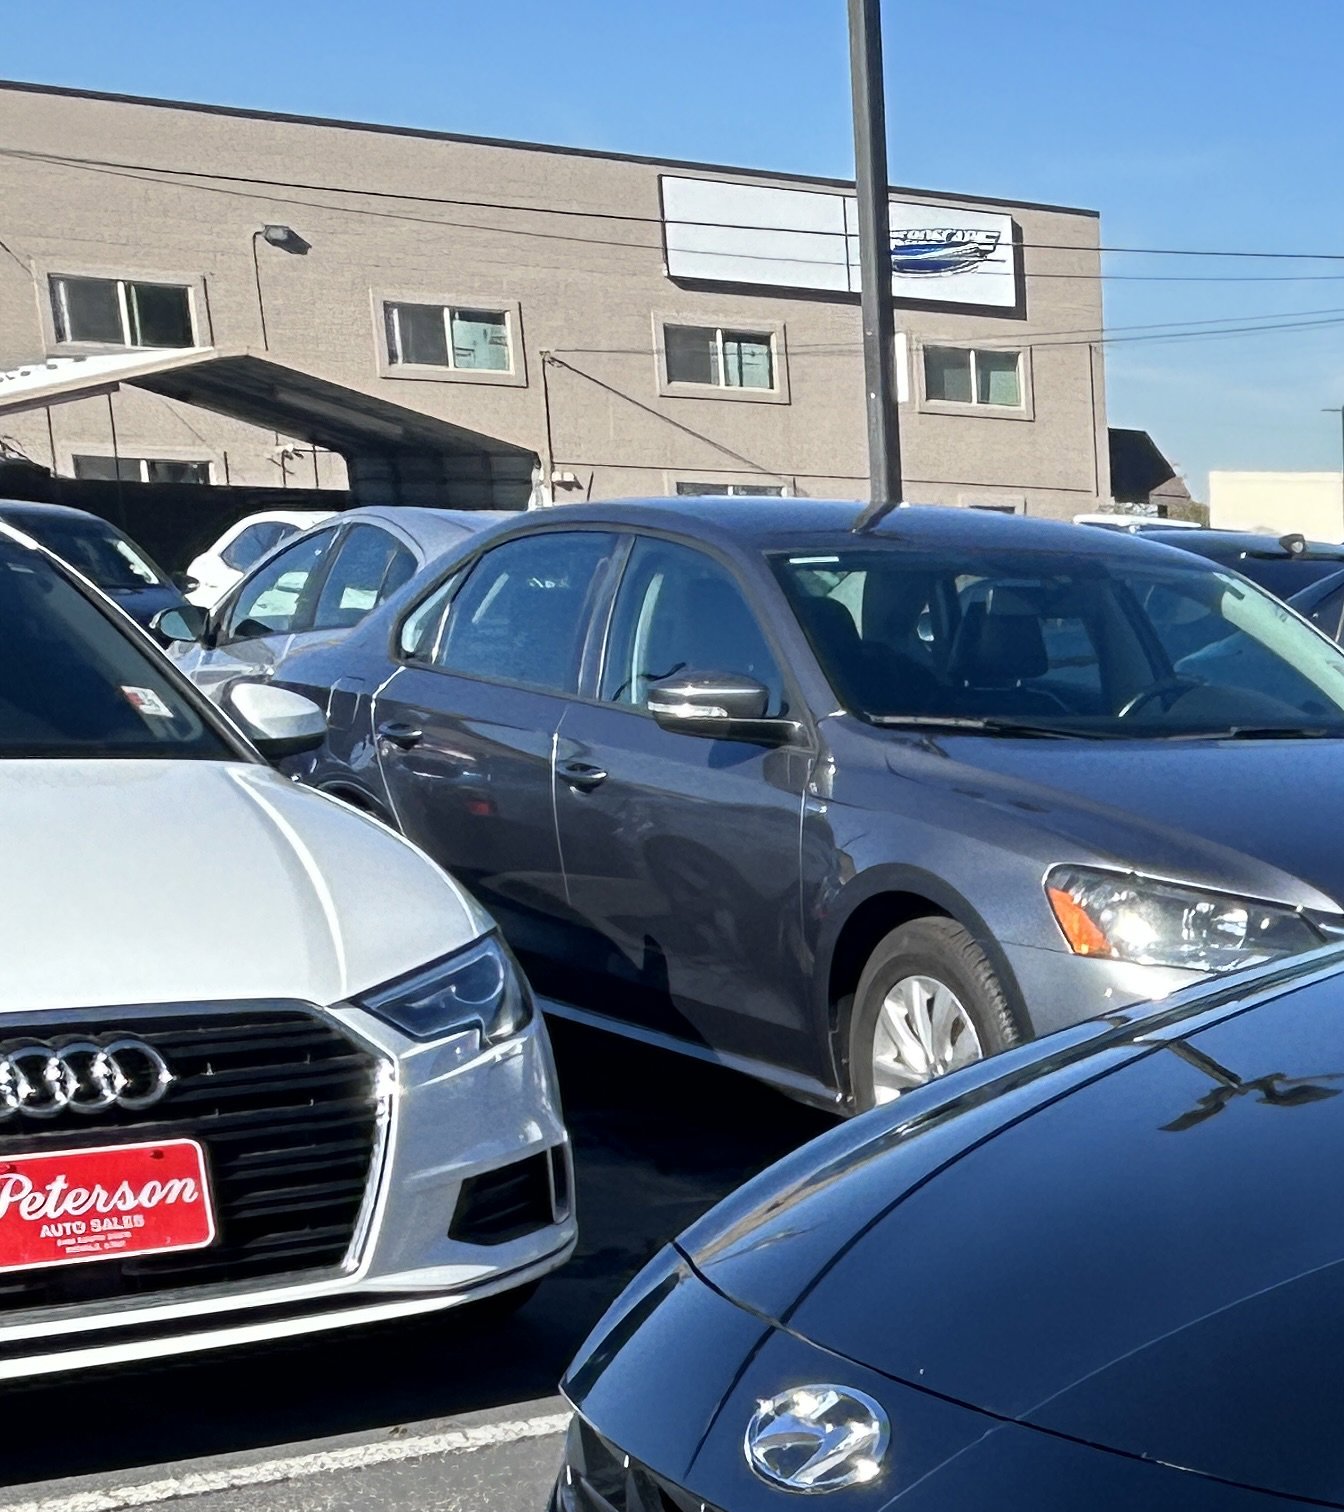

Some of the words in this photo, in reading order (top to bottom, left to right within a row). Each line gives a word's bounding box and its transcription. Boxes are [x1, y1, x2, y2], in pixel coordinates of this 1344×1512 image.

[0, 1173, 198, 1221] Peterson
[40, 1221, 86, 1238] AUTO
[90, 1214, 145, 1232] SALES
